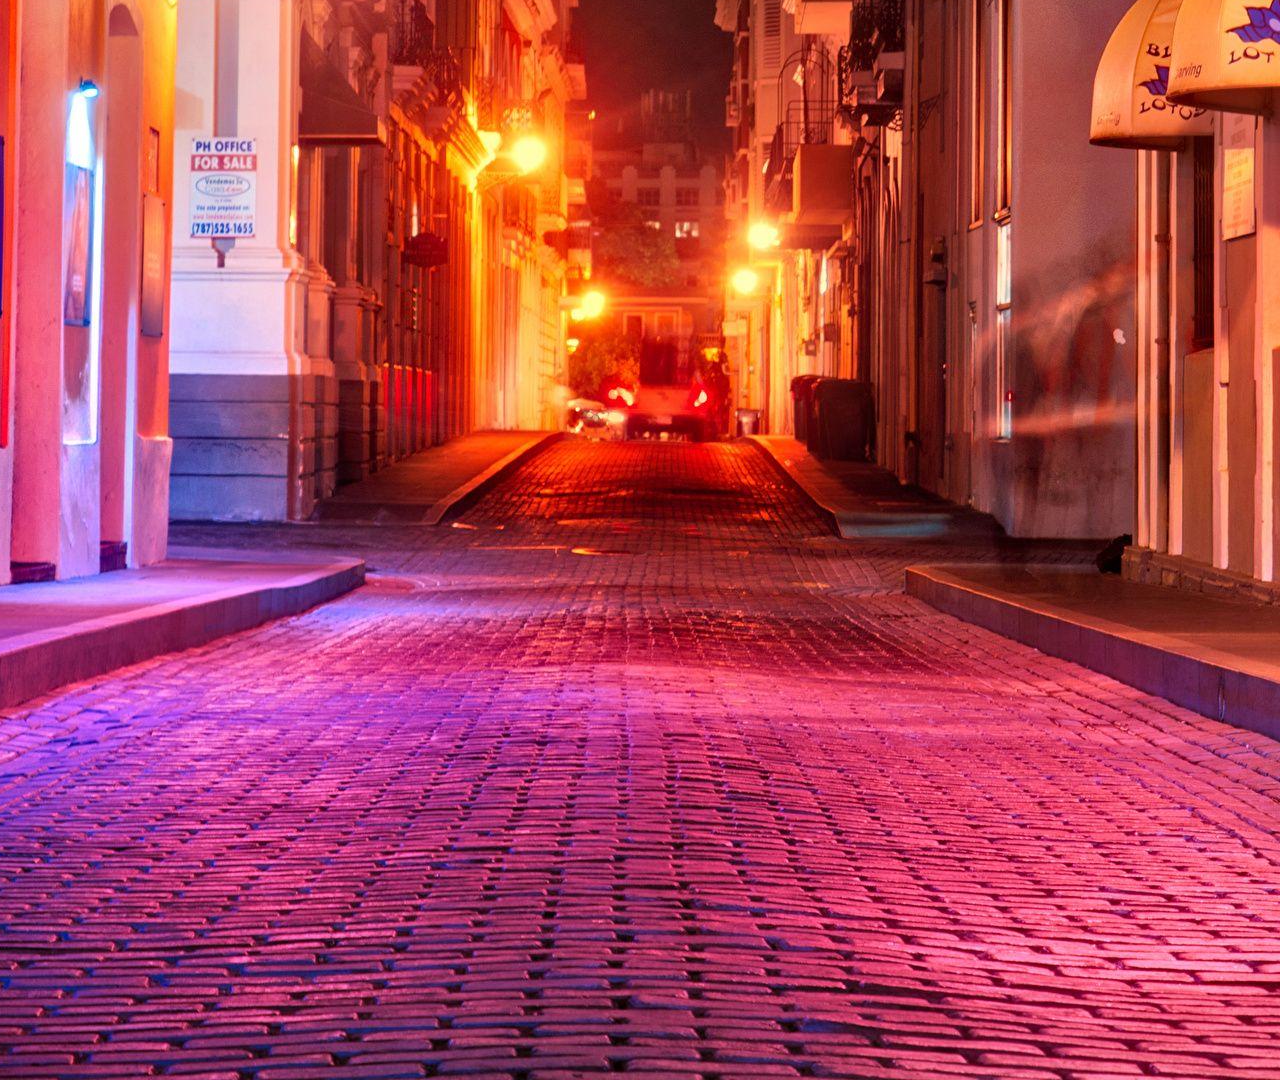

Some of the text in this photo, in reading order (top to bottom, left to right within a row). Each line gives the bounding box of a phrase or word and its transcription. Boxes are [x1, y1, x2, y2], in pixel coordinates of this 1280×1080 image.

[1146, 43, 1171, 58] BL
[195, 141, 253, 153] PH OFFICE
[194, 156, 253, 170] FOR SALE
